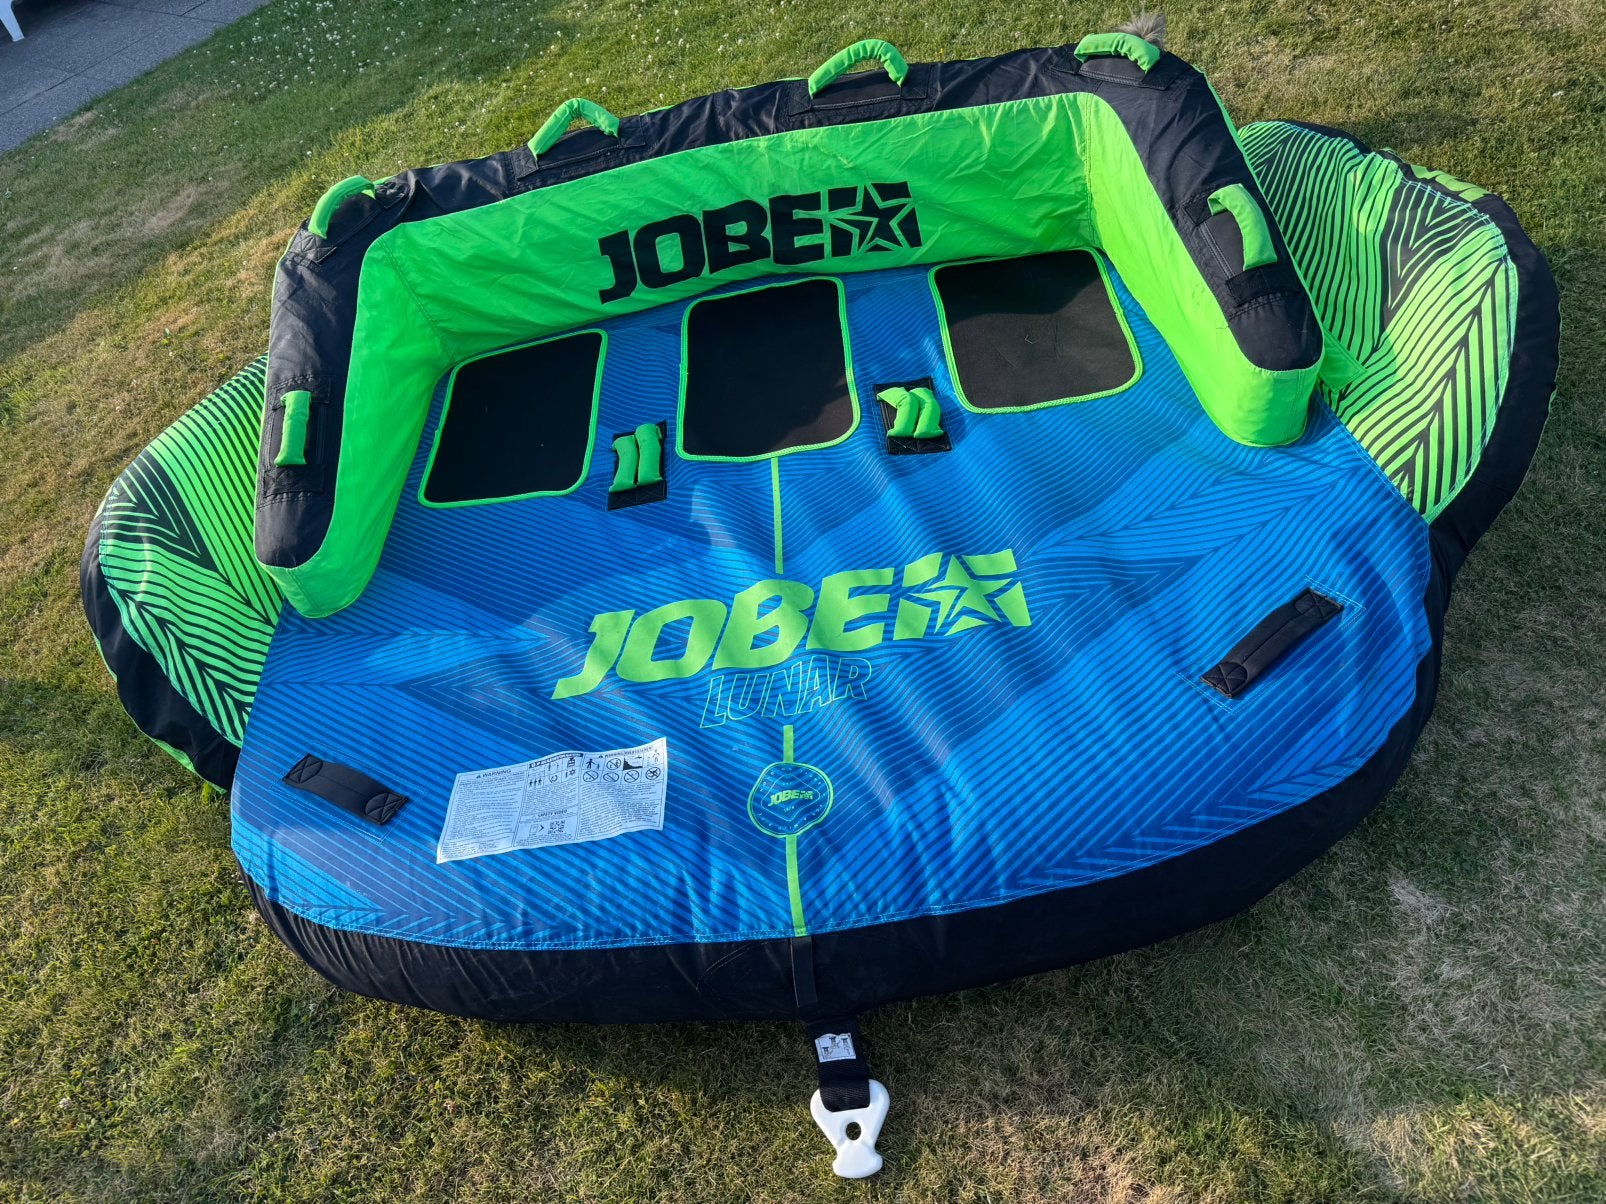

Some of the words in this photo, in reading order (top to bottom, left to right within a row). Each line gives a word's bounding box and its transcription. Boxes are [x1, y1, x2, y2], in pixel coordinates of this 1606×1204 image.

[598, 191, 827, 305] JOBE
[551, 567, 895, 700] JOBE
[699, 655, 873, 729] LUNAR
[768, 789, 800, 807] JOBE
